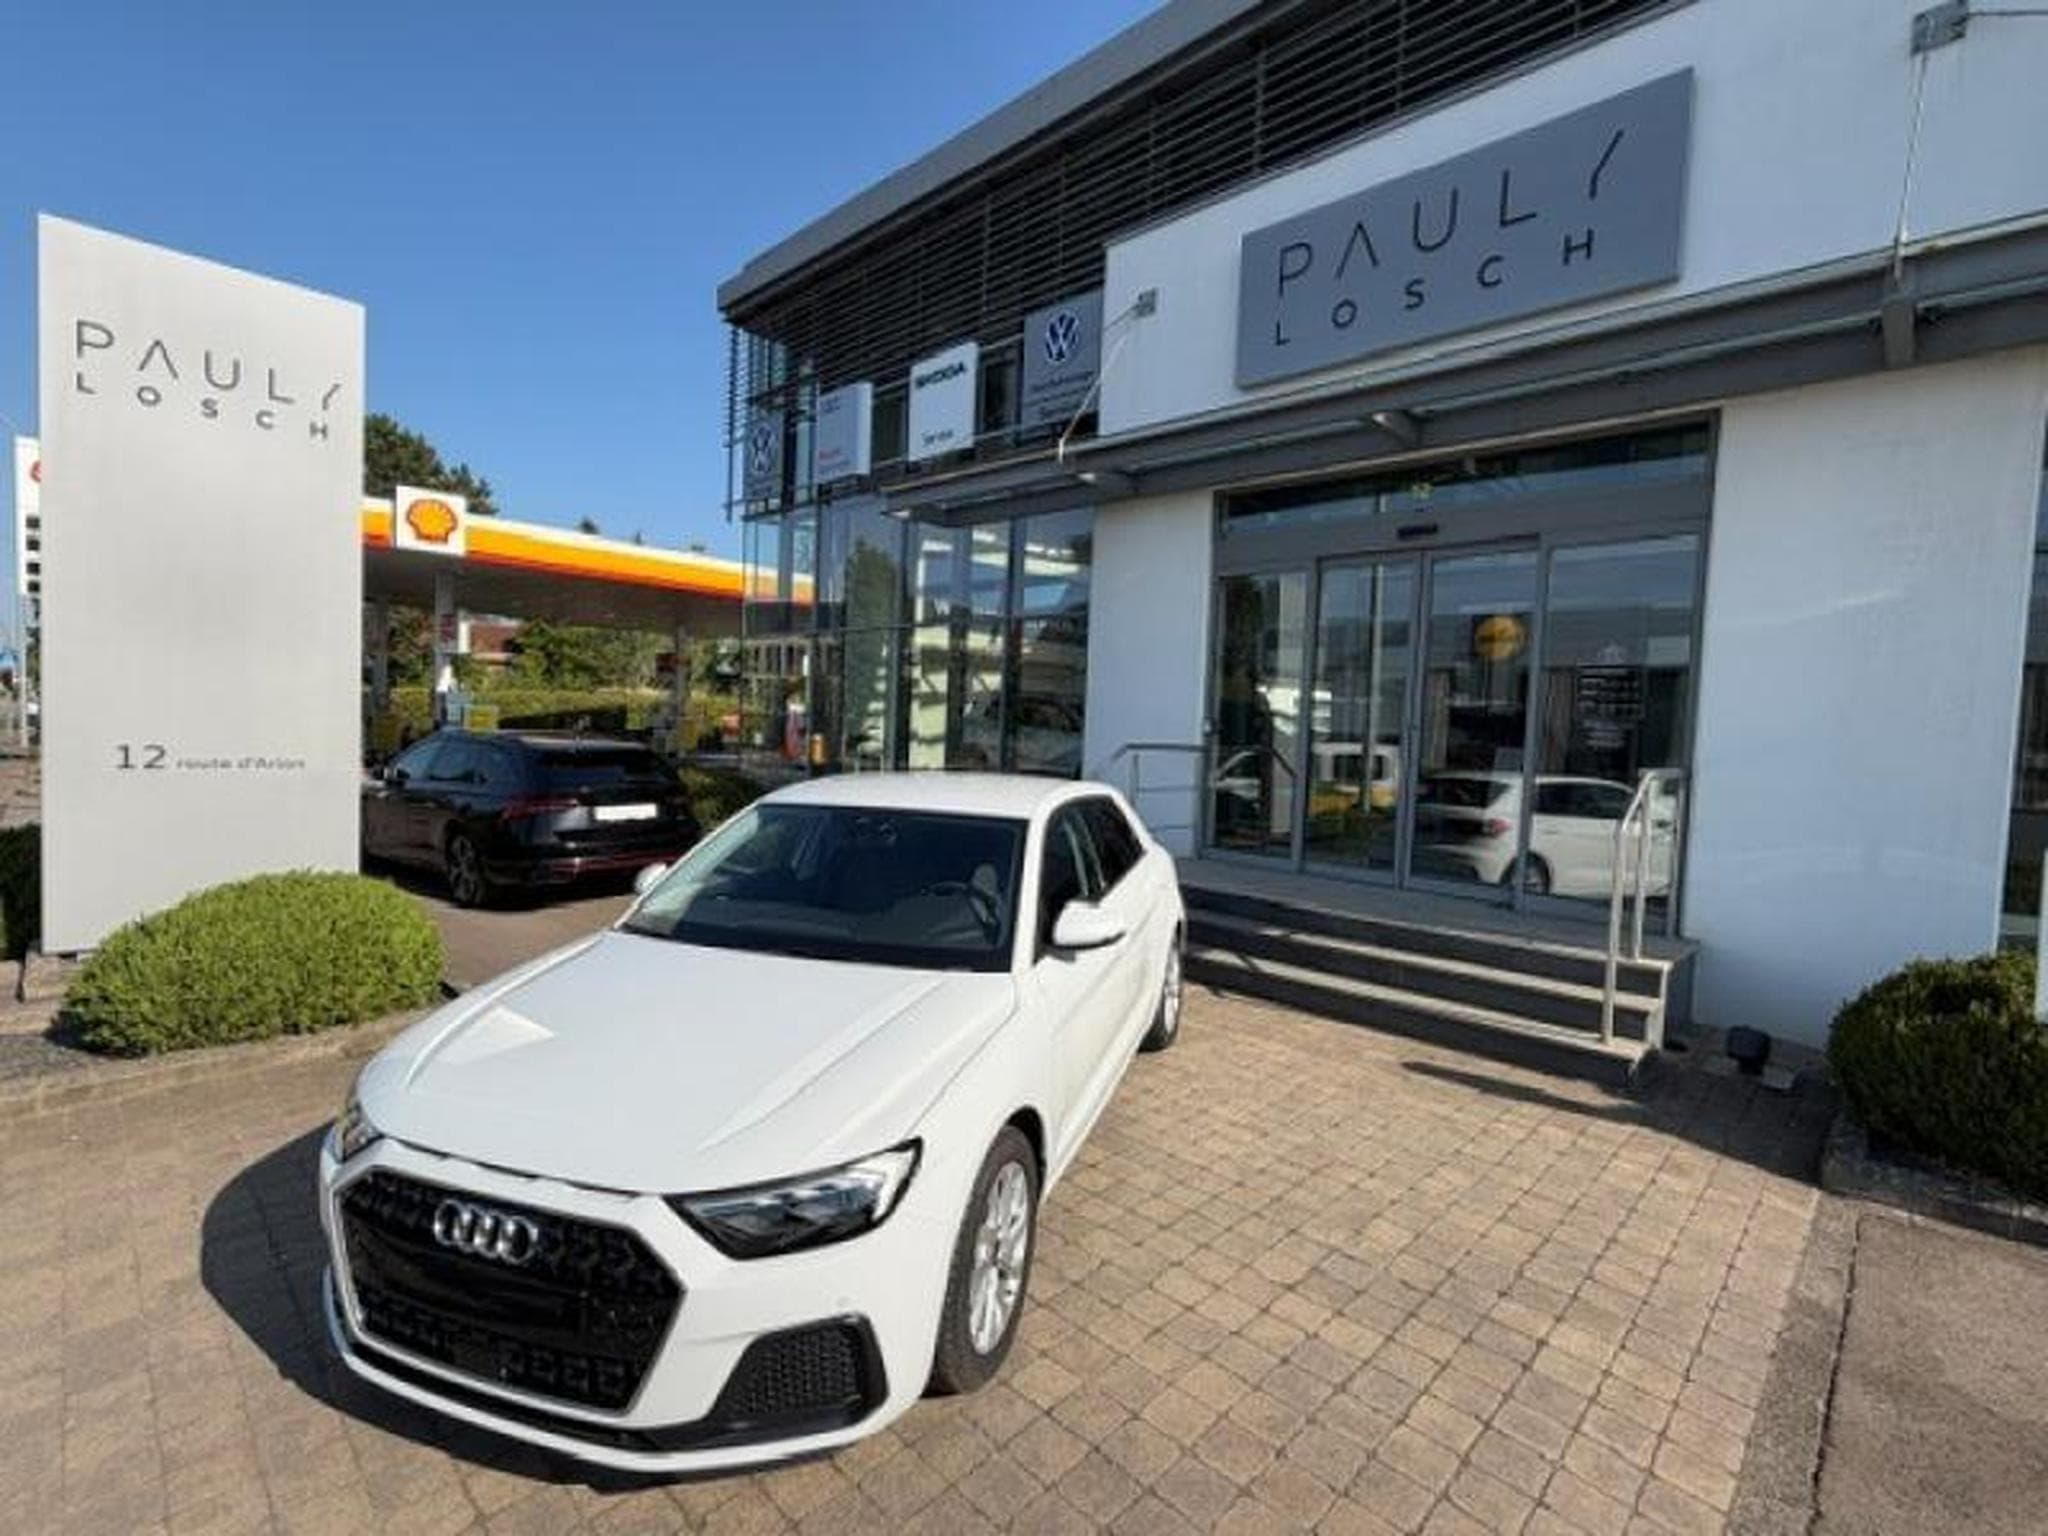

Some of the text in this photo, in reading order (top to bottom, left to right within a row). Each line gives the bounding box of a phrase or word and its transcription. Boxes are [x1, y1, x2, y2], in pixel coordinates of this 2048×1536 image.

[1275, 228, 1596, 347] LOSCH
[75, 371, 329, 440] LOSCH
[116, 743, 167, 770] 12
